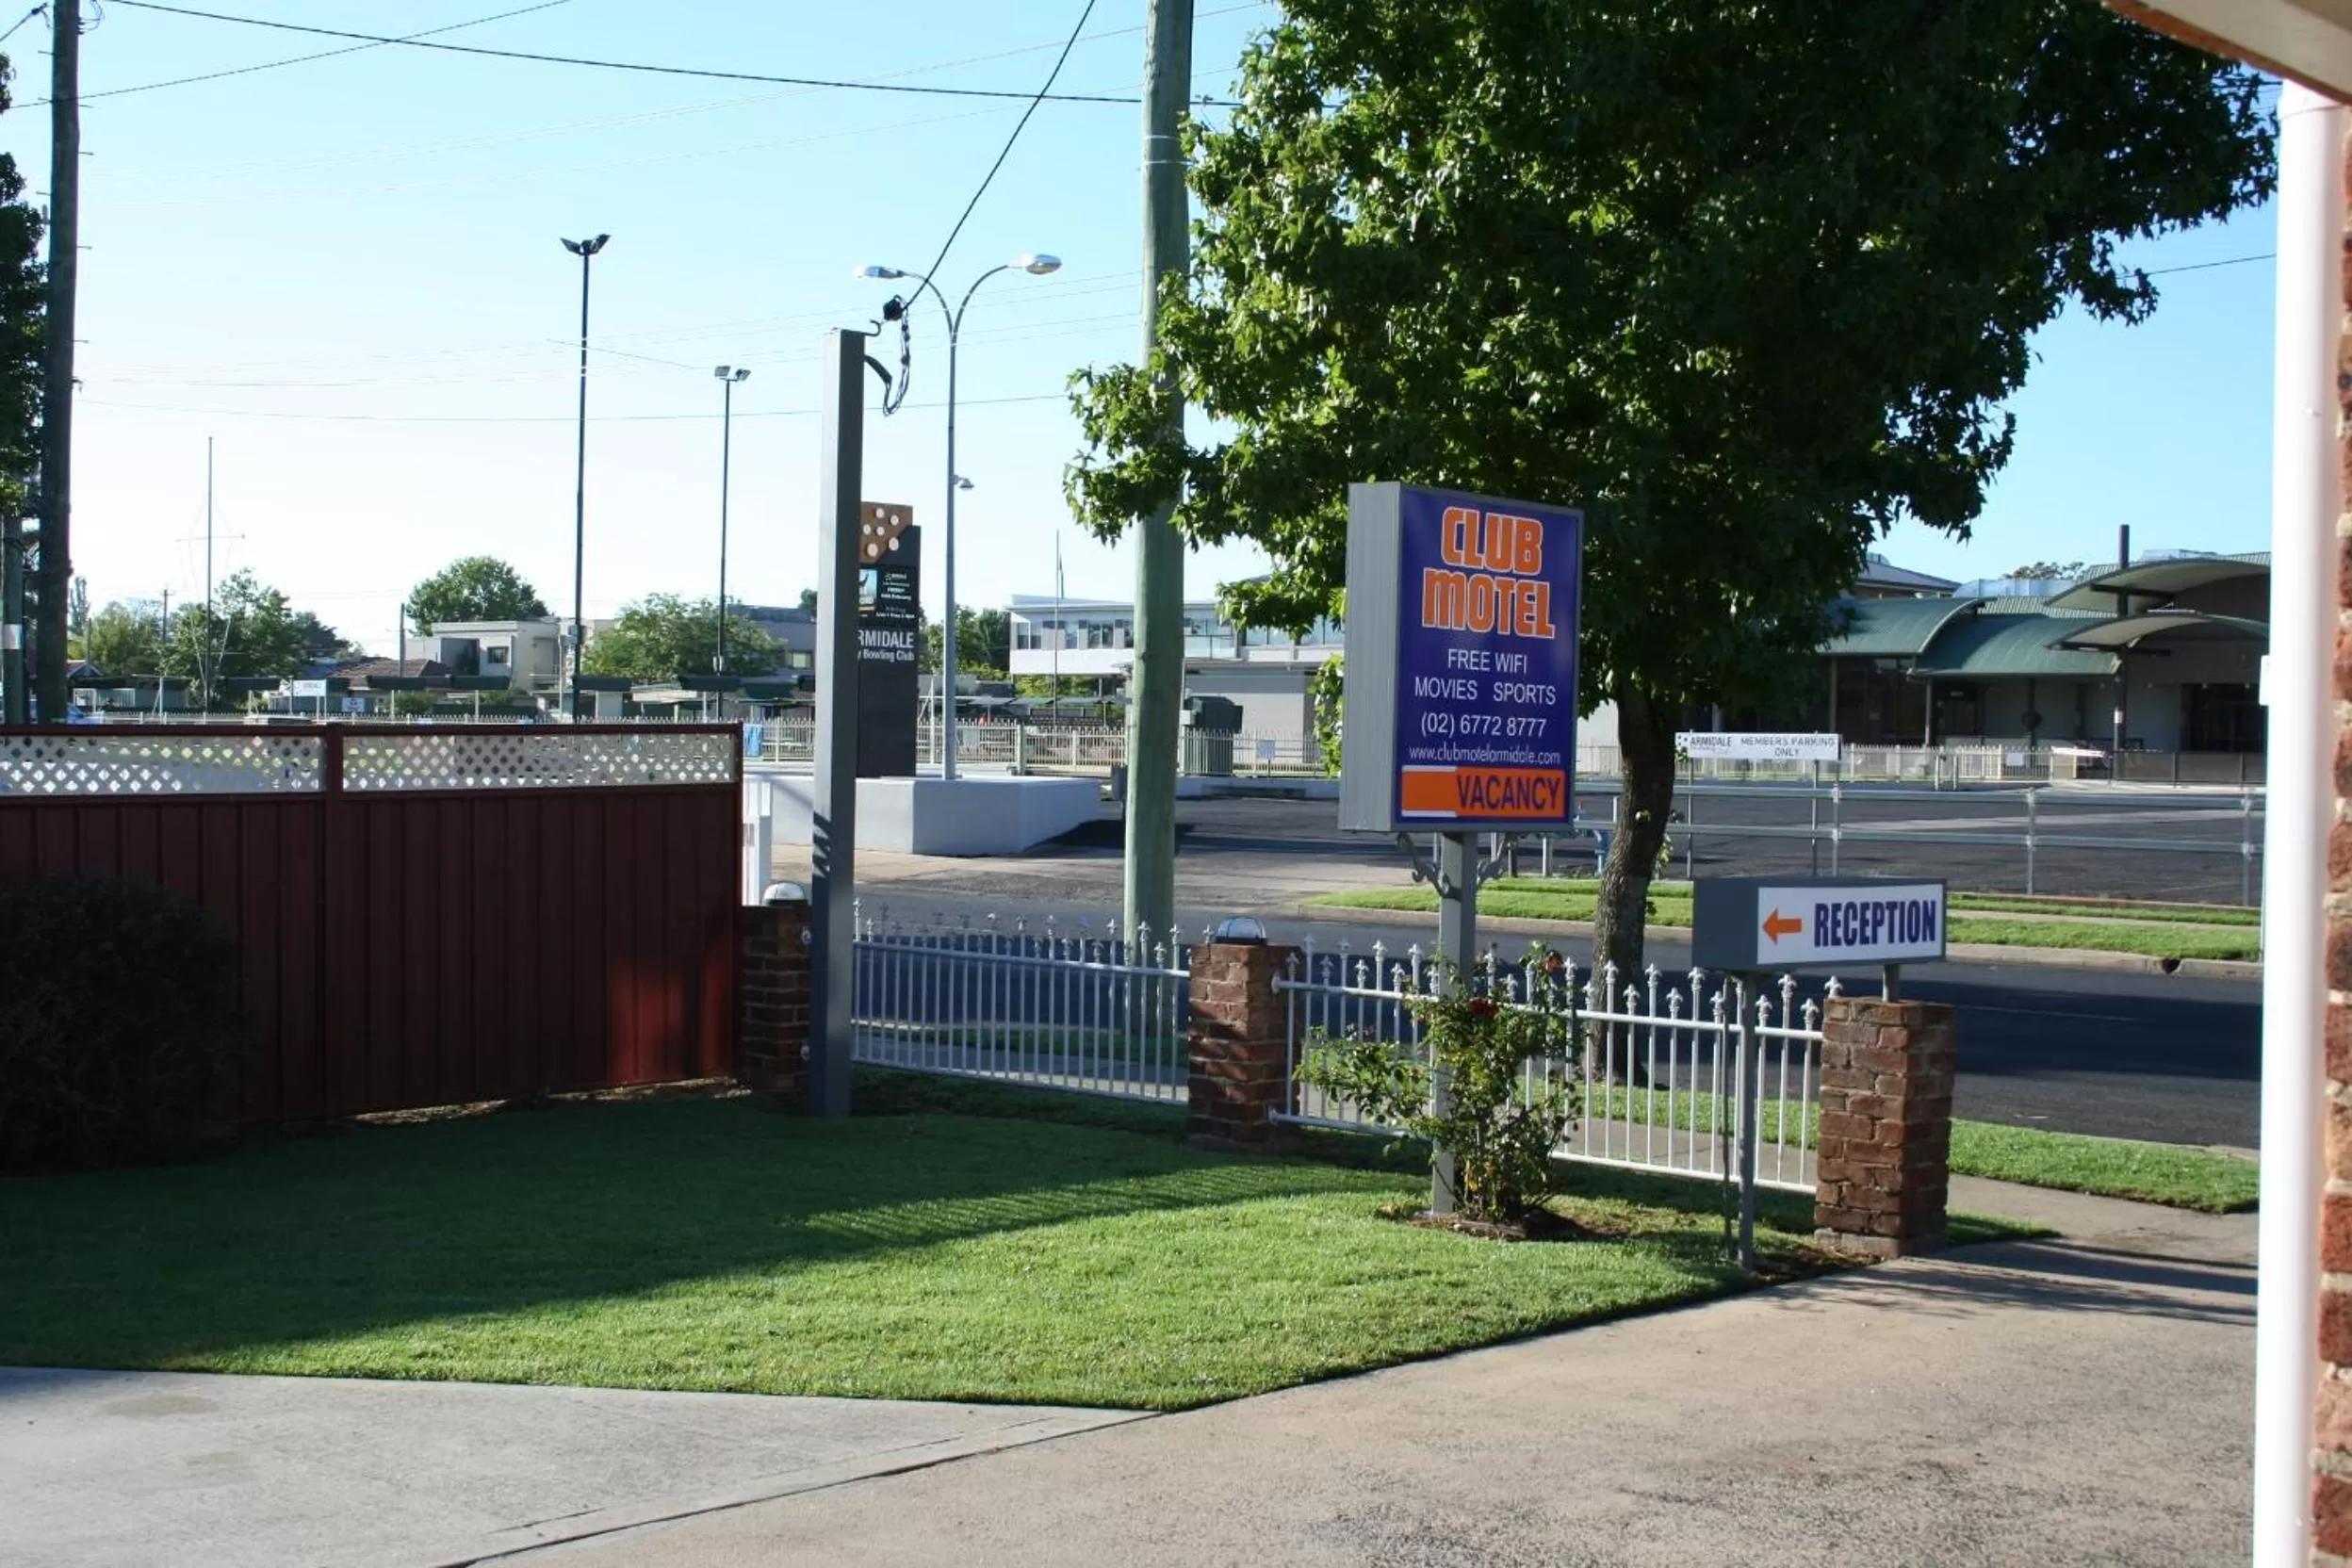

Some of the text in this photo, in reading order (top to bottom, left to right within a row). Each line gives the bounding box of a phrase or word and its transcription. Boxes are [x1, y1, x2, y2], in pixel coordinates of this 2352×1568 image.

[1441, 507, 1544, 576] CLUB
[1422, 567, 1556, 638] MOTEL
[858, 629, 915, 648] RMIDALE
[896, 650, 915, 662] Club
[1447, 648, 1527, 675] FREE WIFI
[1414, 677, 1557, 705] MOVIES SPORTS
[1421, 712, 1547, 738] (02) 6772 8777
[1690, 736, 1731, 746] ARMIDALE
[1740, 736, 1836, 746] MEMBERS PARKING
[1774, 747, 1799, 757] ONLY
[1456, 775, 1561, 810] VACANCY
[1814, 899, 1936, 948] RECEPTION
